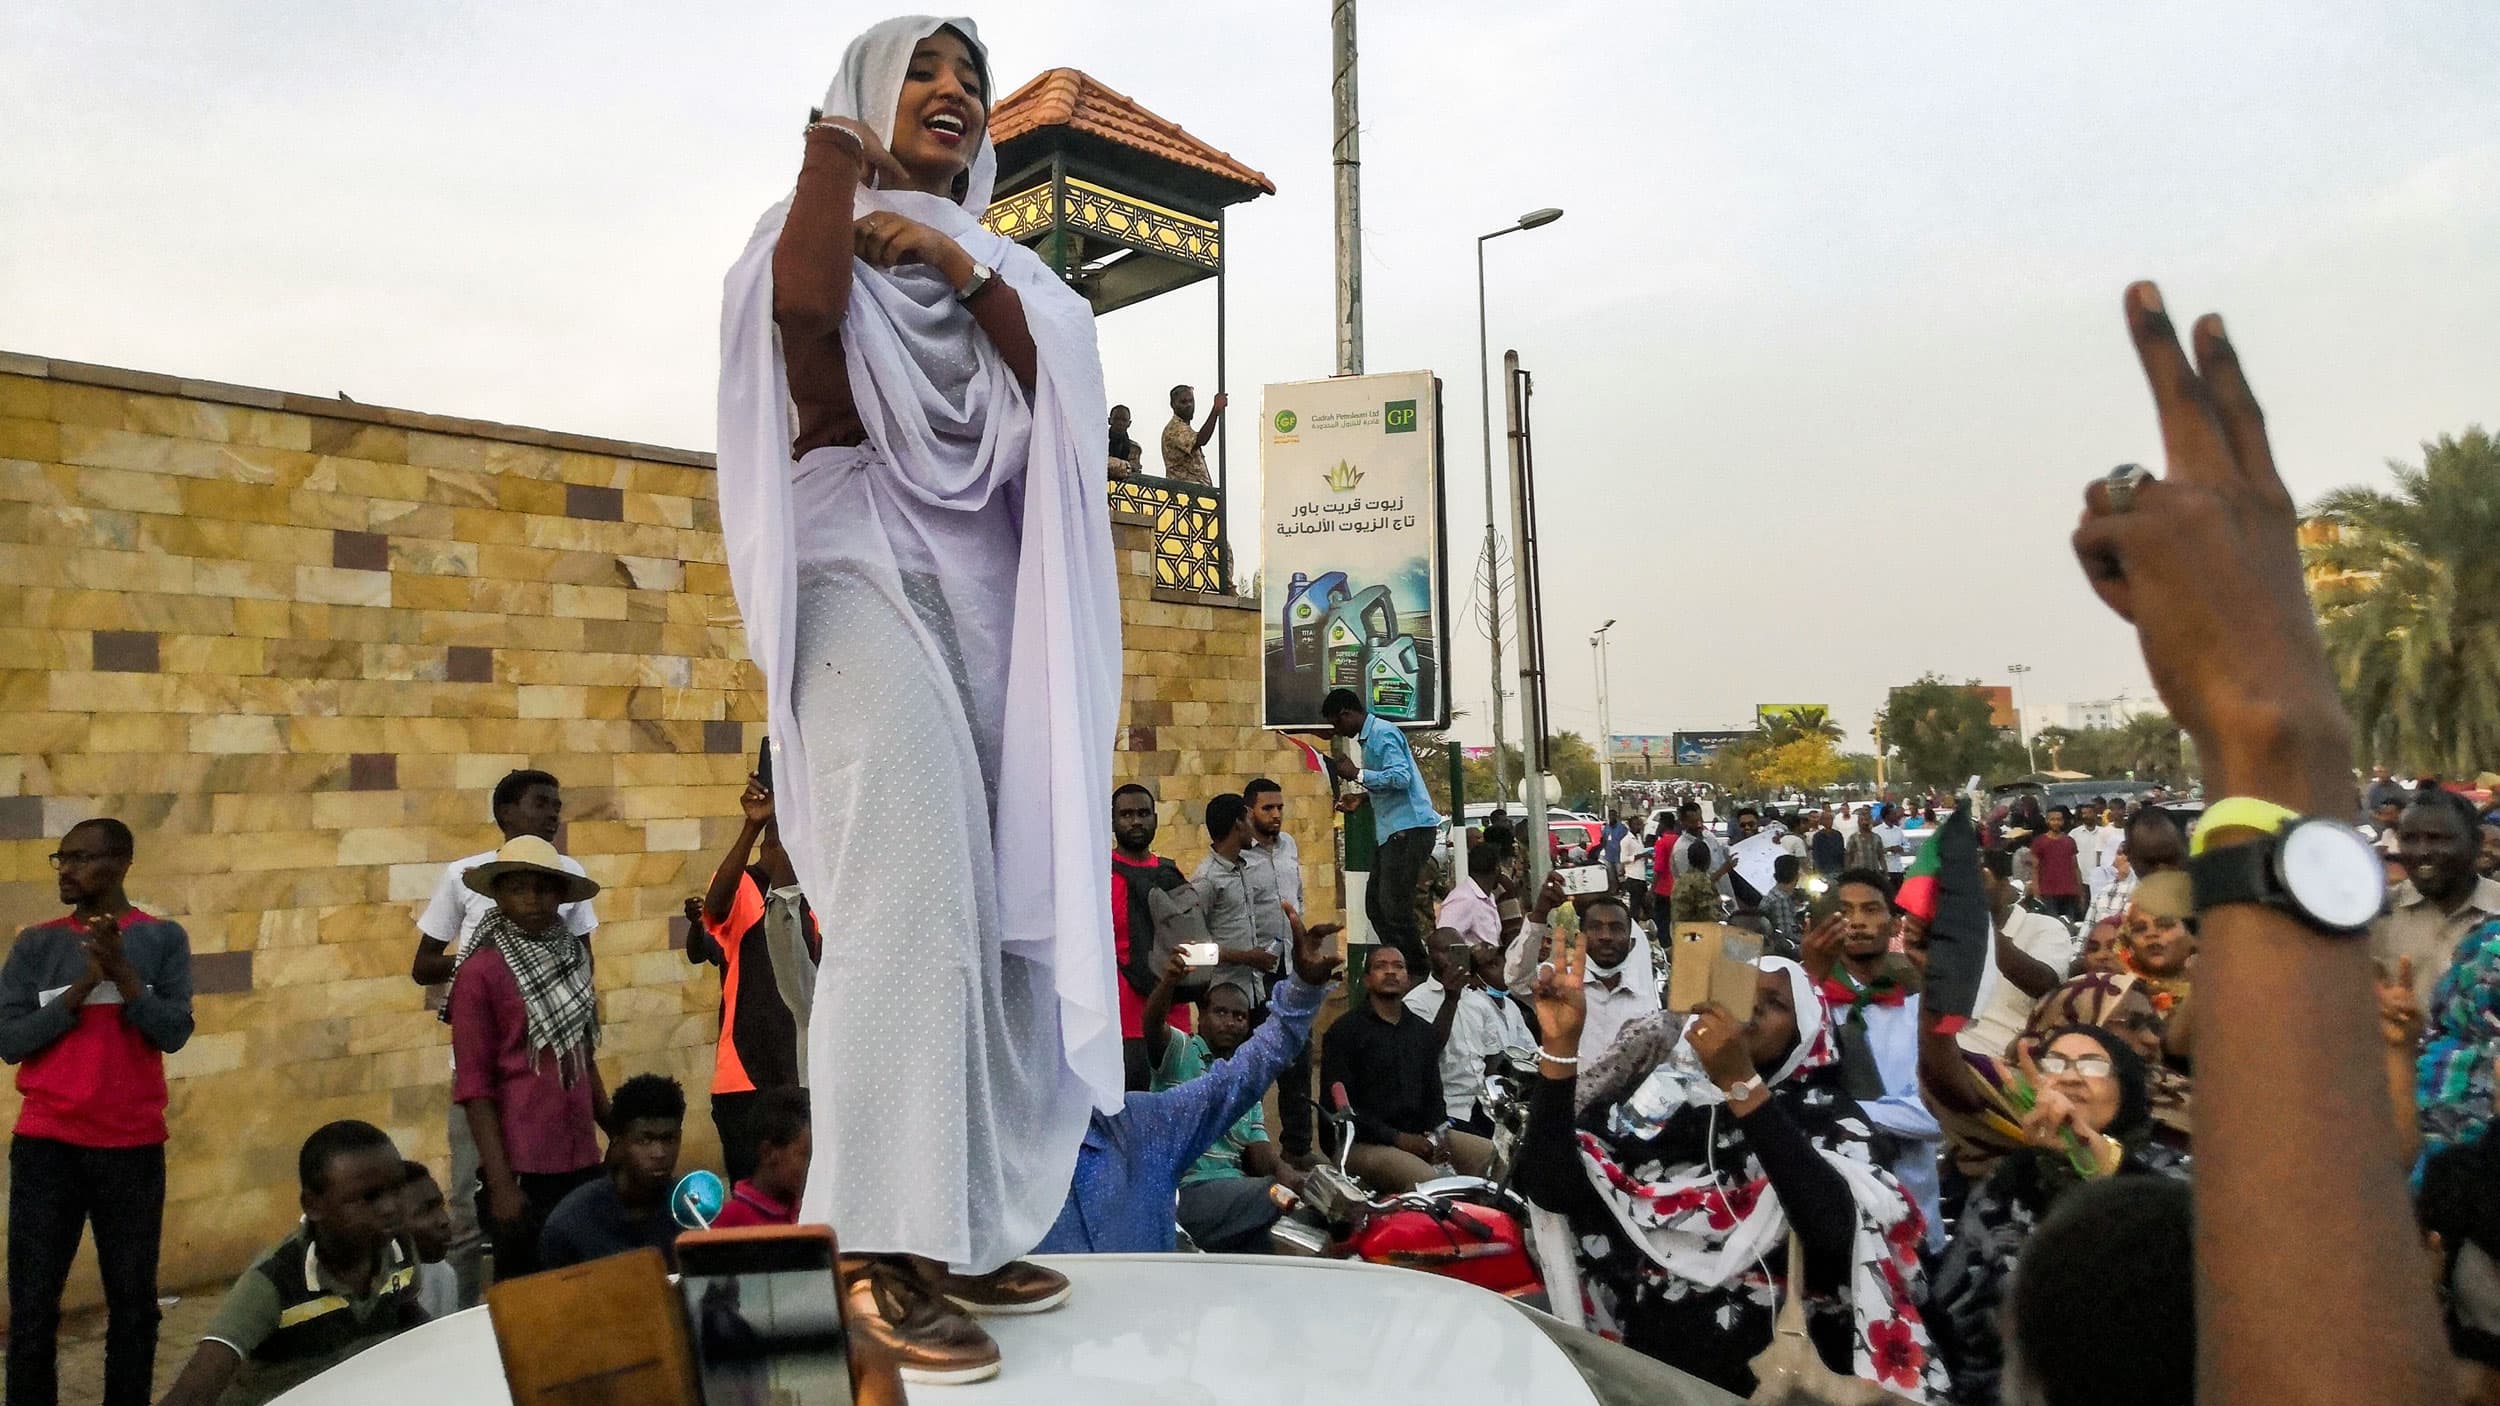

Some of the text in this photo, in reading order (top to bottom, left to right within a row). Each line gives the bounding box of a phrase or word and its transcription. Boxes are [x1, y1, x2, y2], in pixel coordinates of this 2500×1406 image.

[1387, 409, 1414, 426] GP
[1292, 496, 1404, 517] زيوت قريت باور
[1277, 515, 1415, 537] تاج الزيوت الألمانية
